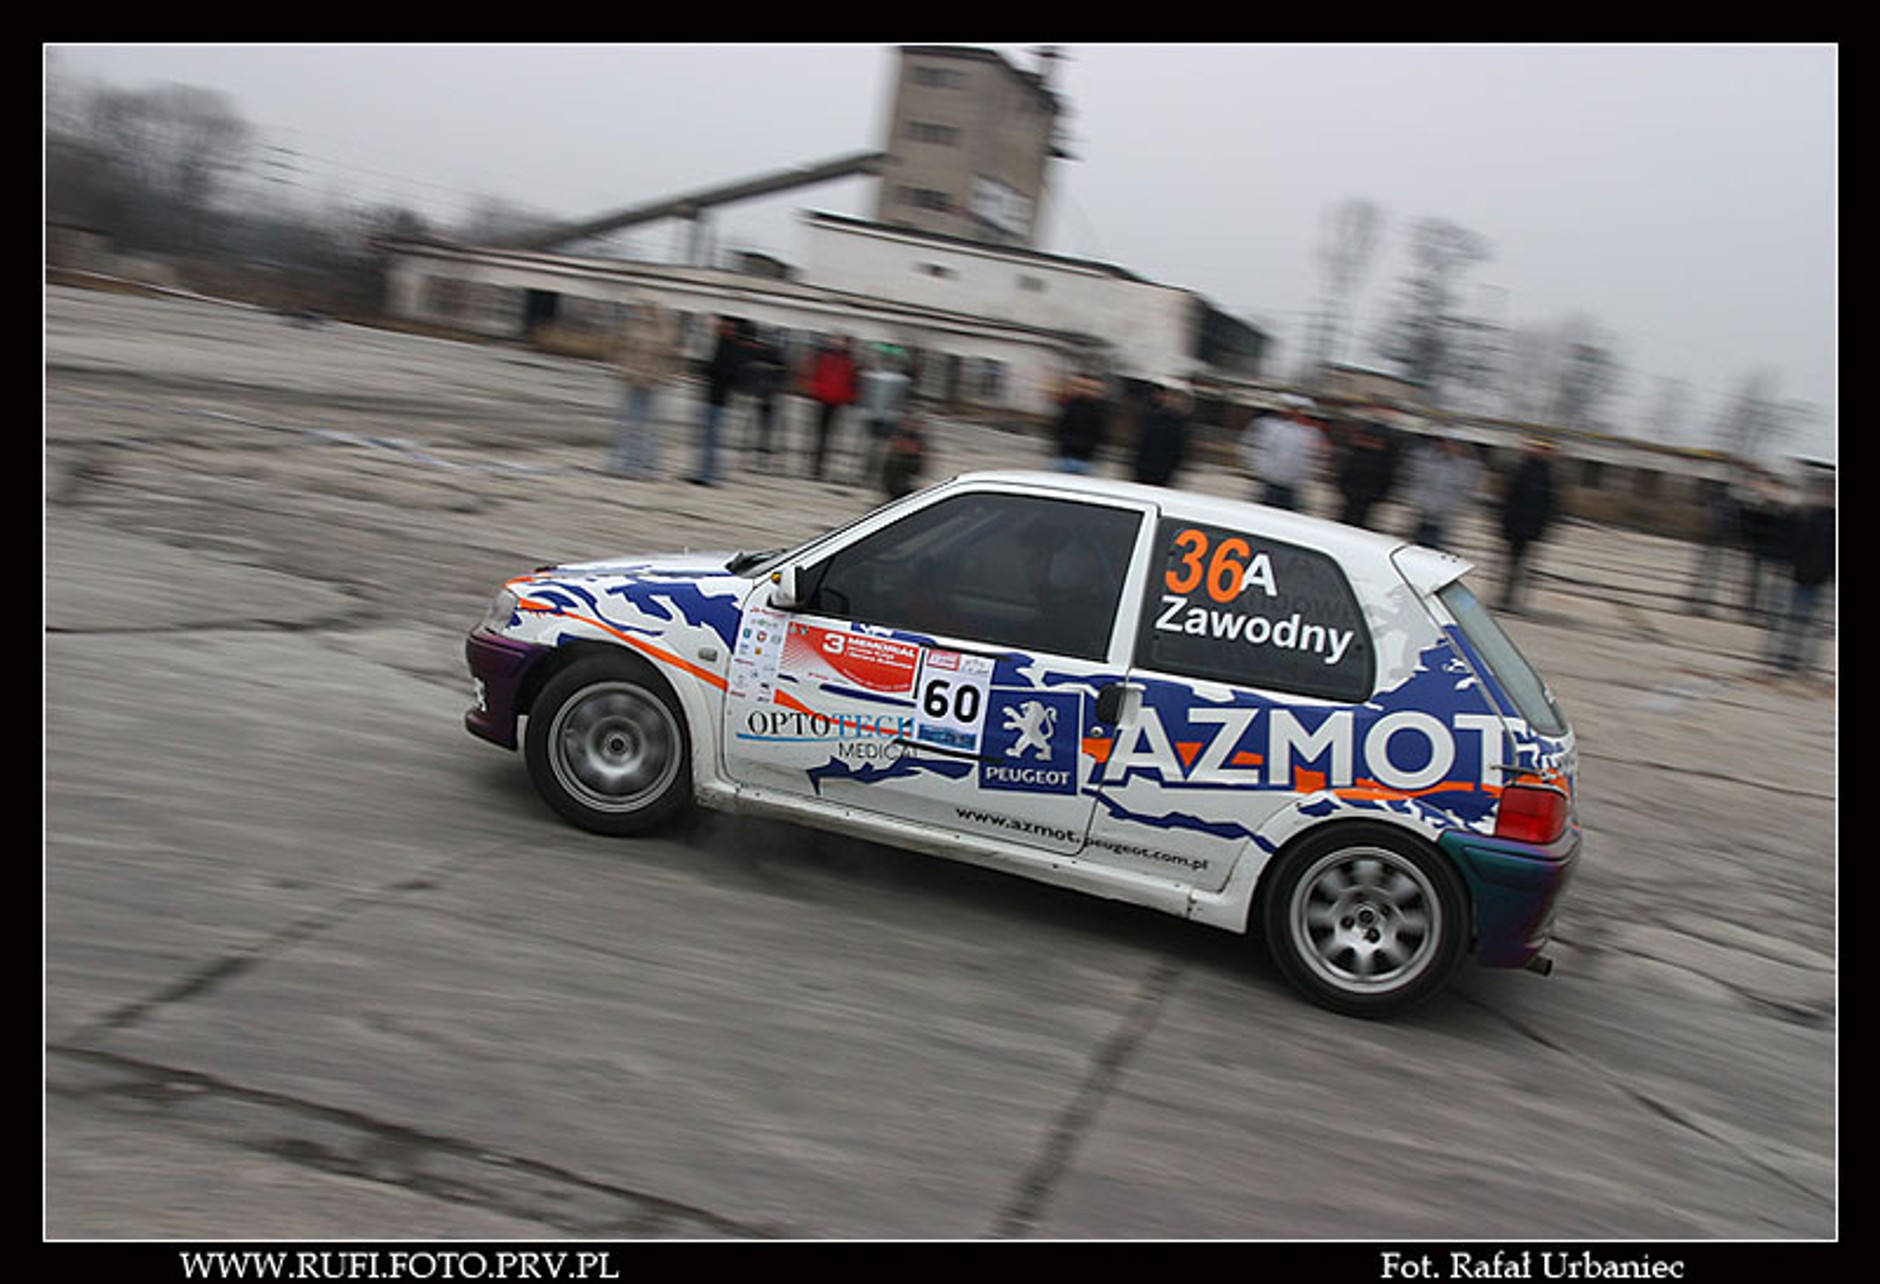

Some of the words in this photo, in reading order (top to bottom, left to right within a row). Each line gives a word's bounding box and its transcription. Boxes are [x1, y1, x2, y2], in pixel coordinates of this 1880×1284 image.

[822, 632, 847, 655] 3
[847, 636, 915, 659] MEMORIAL
[1155, 595, 1355, 665] Zawodny
[923, 679, 981, 724] 60
[1103, 706, 1527, 791] AZMOT
[985, 765, 1072, 787] PEUGEOT
